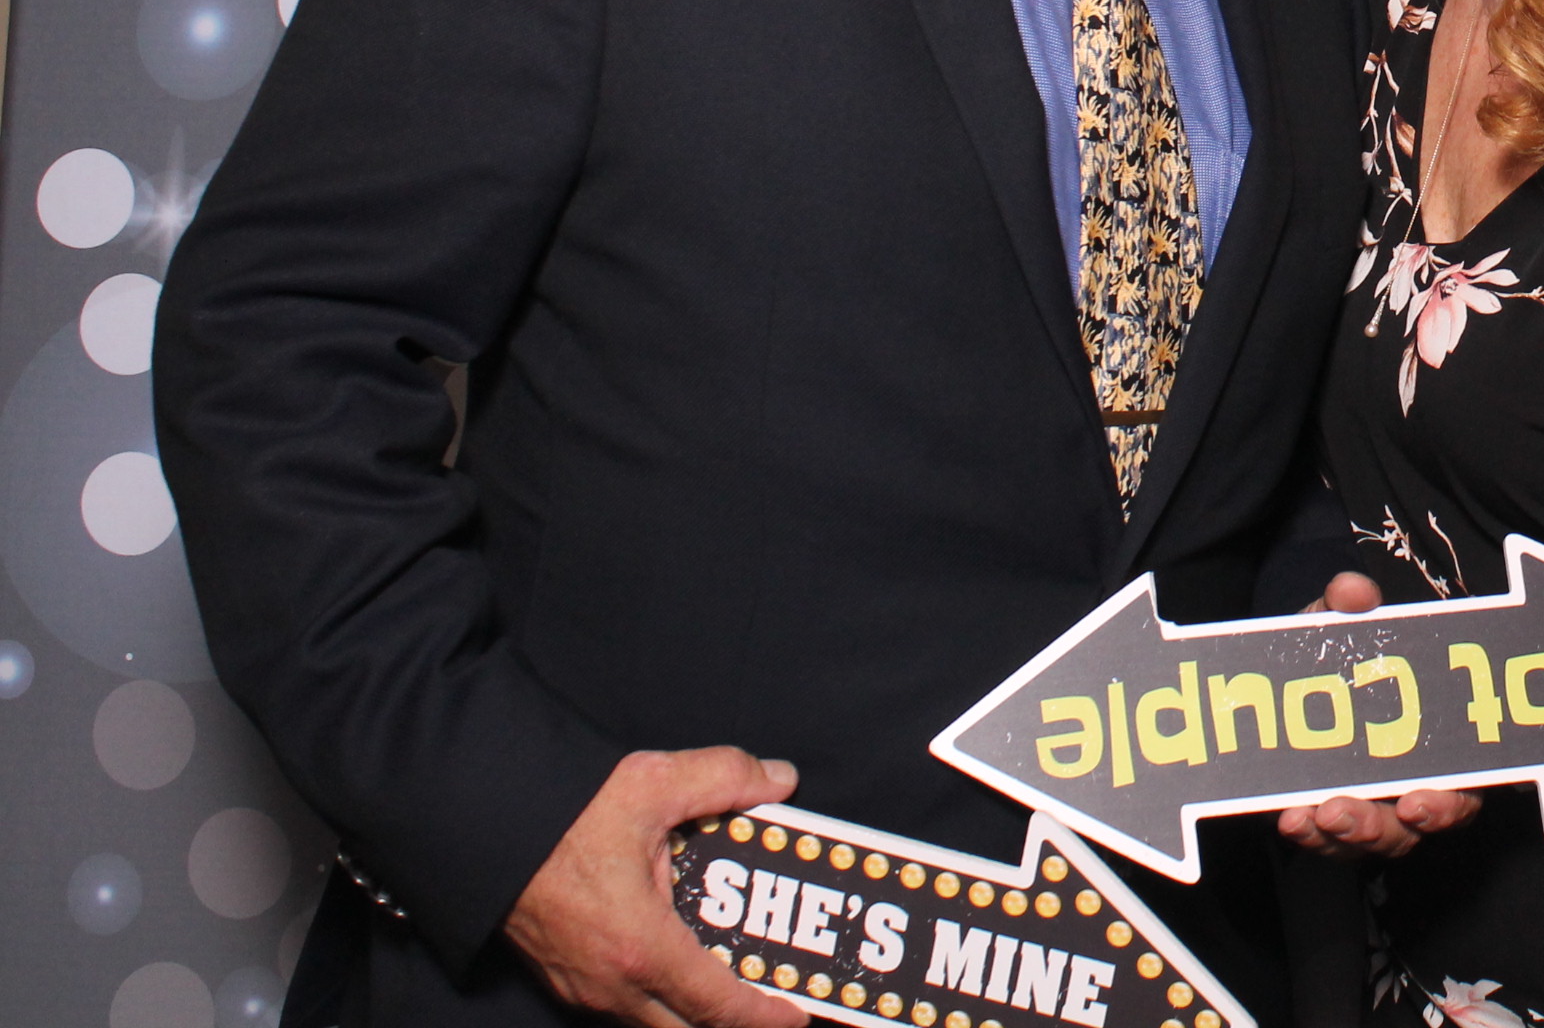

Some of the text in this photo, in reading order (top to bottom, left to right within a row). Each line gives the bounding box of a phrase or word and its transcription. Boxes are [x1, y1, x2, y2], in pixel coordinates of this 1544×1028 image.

[1035, 654, 1422, 788] Couple
[699, 858, 1116, 1026] SHE'S MINE
